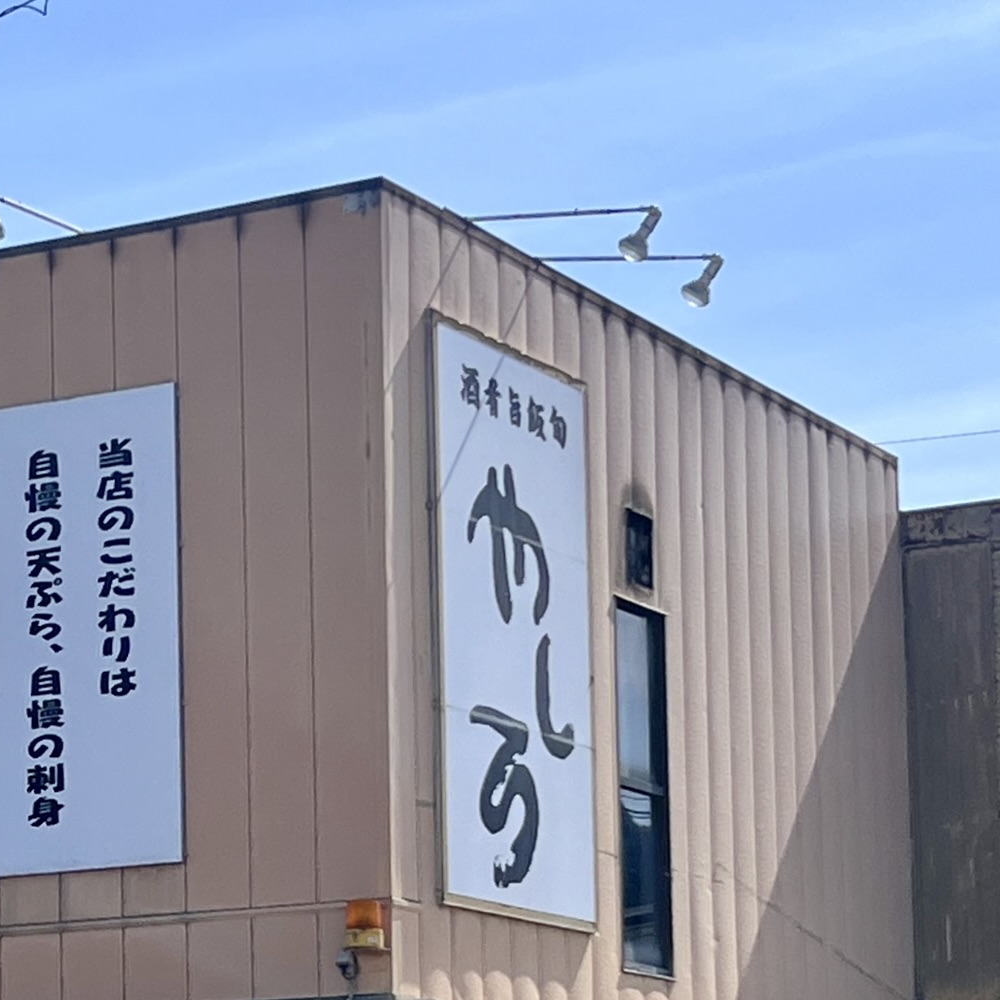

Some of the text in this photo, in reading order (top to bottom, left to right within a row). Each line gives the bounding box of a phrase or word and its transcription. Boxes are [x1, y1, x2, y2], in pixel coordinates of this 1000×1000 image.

[24, 450, 64, 827] 自慢の天ぷら、自慢の刺身
[96, 438, 136, 696] 当店のこだわりは
[467, 464, 574, 888] やしる
